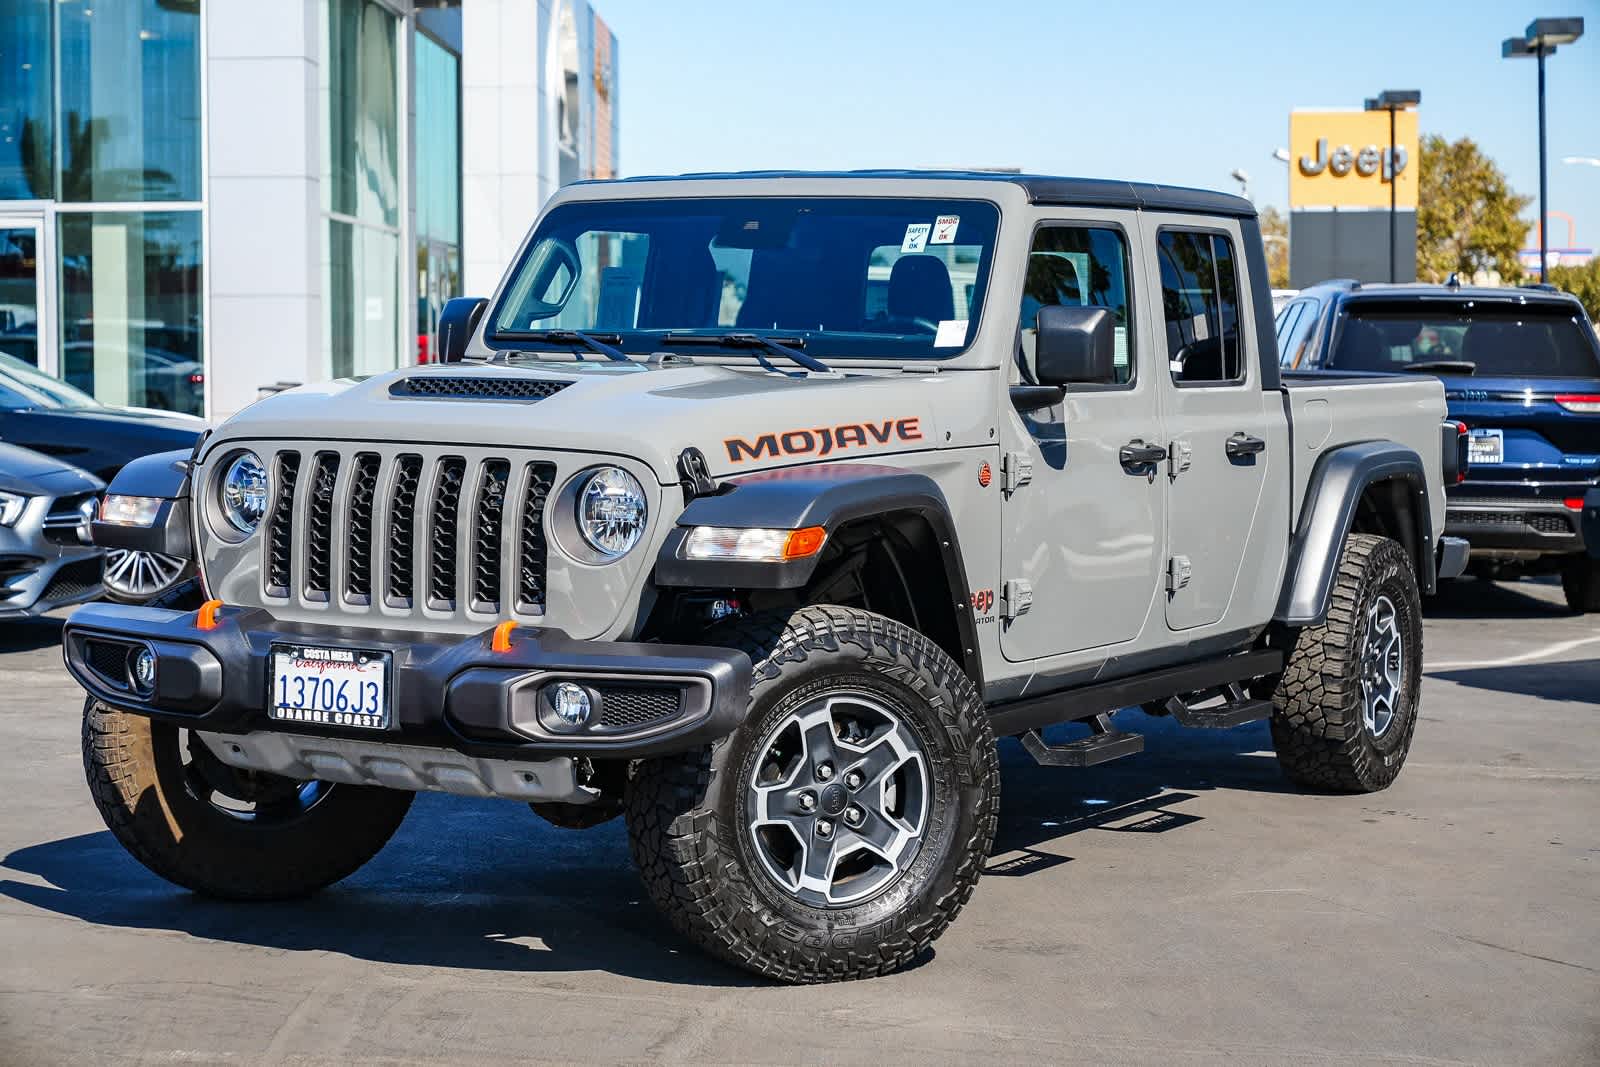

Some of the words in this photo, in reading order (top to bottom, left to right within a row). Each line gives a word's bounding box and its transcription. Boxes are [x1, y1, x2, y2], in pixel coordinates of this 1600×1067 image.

[1299, 137, 1408, 184] Jeep
[724, 417, 923, 462] MOJAVE
[969, 589, 994, 615] eep
[303, 648, 330, 660] COSTA
[330, 650, 354, 662] MESA
[279, 674, 379, 714] 13706J3
[276, 707, 330, 722] ORANGE
[334, 711, 381, 727] COAST
